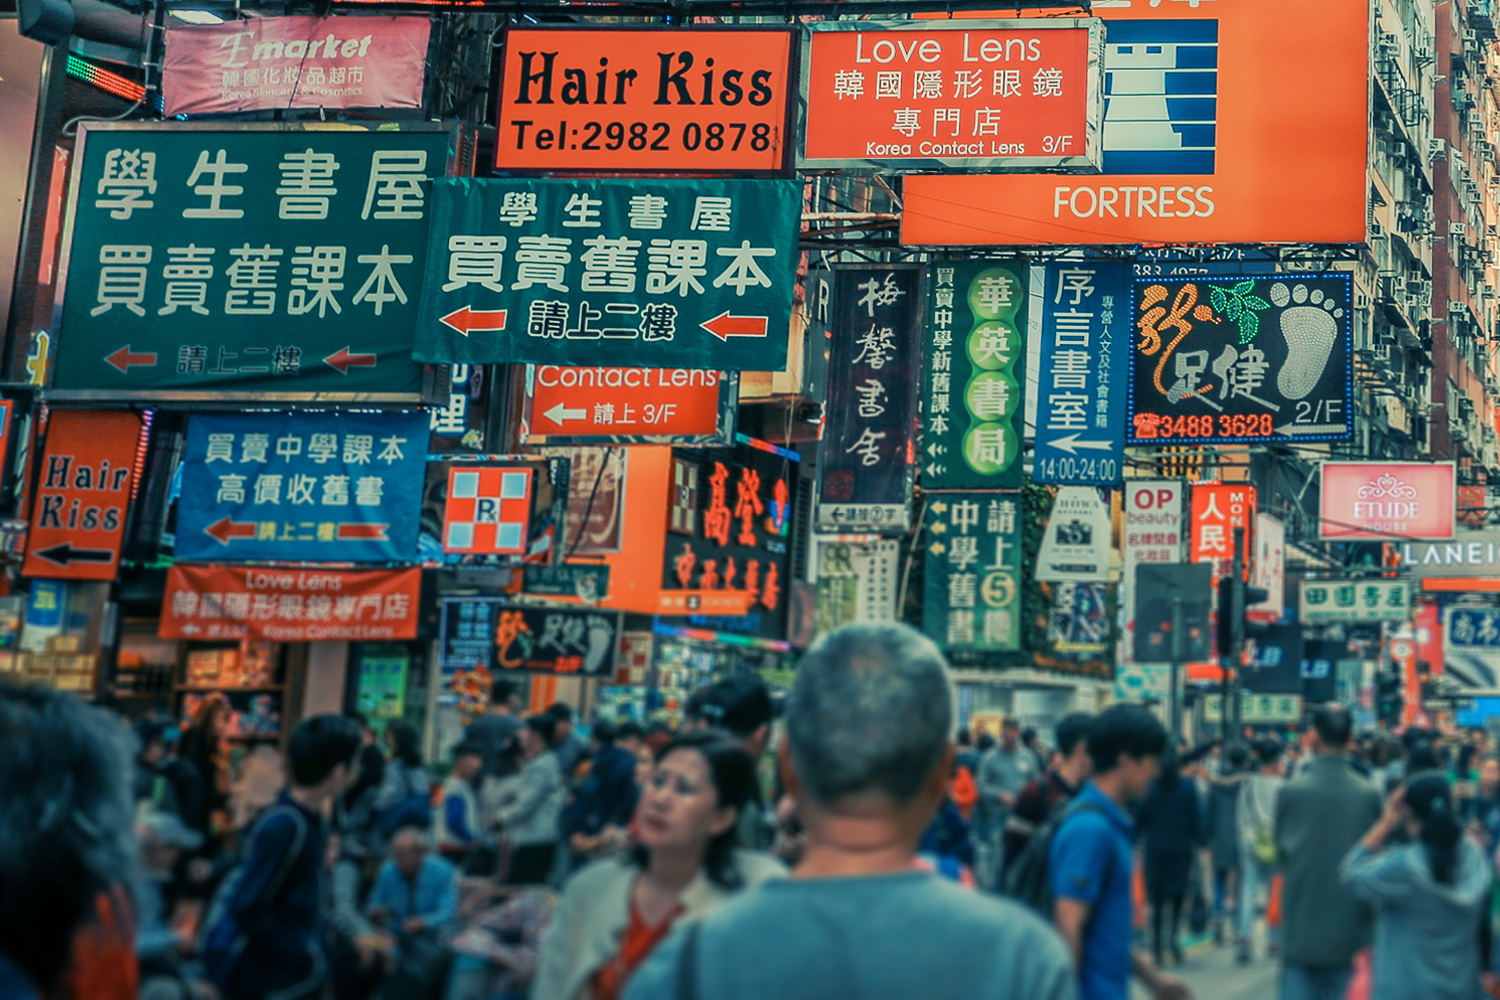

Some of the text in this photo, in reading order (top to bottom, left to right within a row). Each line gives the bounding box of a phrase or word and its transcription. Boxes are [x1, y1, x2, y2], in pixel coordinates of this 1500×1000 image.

[855, 33, 1042, 63] Love Lens
[513, 50, 774, 106] Hair Kiss
[833, 67, 1064, 101] 韓國隱形眼鏡
[510, 120, 771, 152] Tel:2982 0878
[891, 105, 1002, 138] 專門店
[866, 135, 1074, 156] Korea Contact Lens 3/F
[95, 147, 428, 221] 學生書屋
[499, 191, 733, 233] 學生書屋
[1053, 187, 1215, 219] FORTRESS
[90, 243, 413, 319] 買賣舊課本
[441, 234, 777, 298] 買賣舊課本
[527, 300, 679, 343] 請上二樓
[175, 345, 303, 375] 請上二樓
[928, 266, 955, 436] 買賣中學新舊課本
[1046, 266, 1097, 431] 序言書室
[537, 365, 717, 389] Contact Lens
[970, 275, 1015, 467] 華英書局
[593, 402, 678, 426] 請上 3/F
[1159, 412, 1274, 438] 3488 3628
[1295, 400, 1342, 424] 2/F
[204, 432, 408, 466] 買賣中學課本
[43, 455, 130, 492] Hair
[1039, 457, 1118, 483] 14:00-24:00
[215, 473, 385, 507] 高價收舊書
[1134, 488, 1174, 510] OP
[37, 494, 121, 532] Kiss
[1127, 511, 1180, 527] beauty
[1353, 501, 1420, 520] ETUDE
[255, 521, 336, 544] 請上二樓
[1198, 491, 1226, 563] 人民
[1364, 522, 1409, 532] HOUSE
[246, 571, 342, 591] Love Lens
